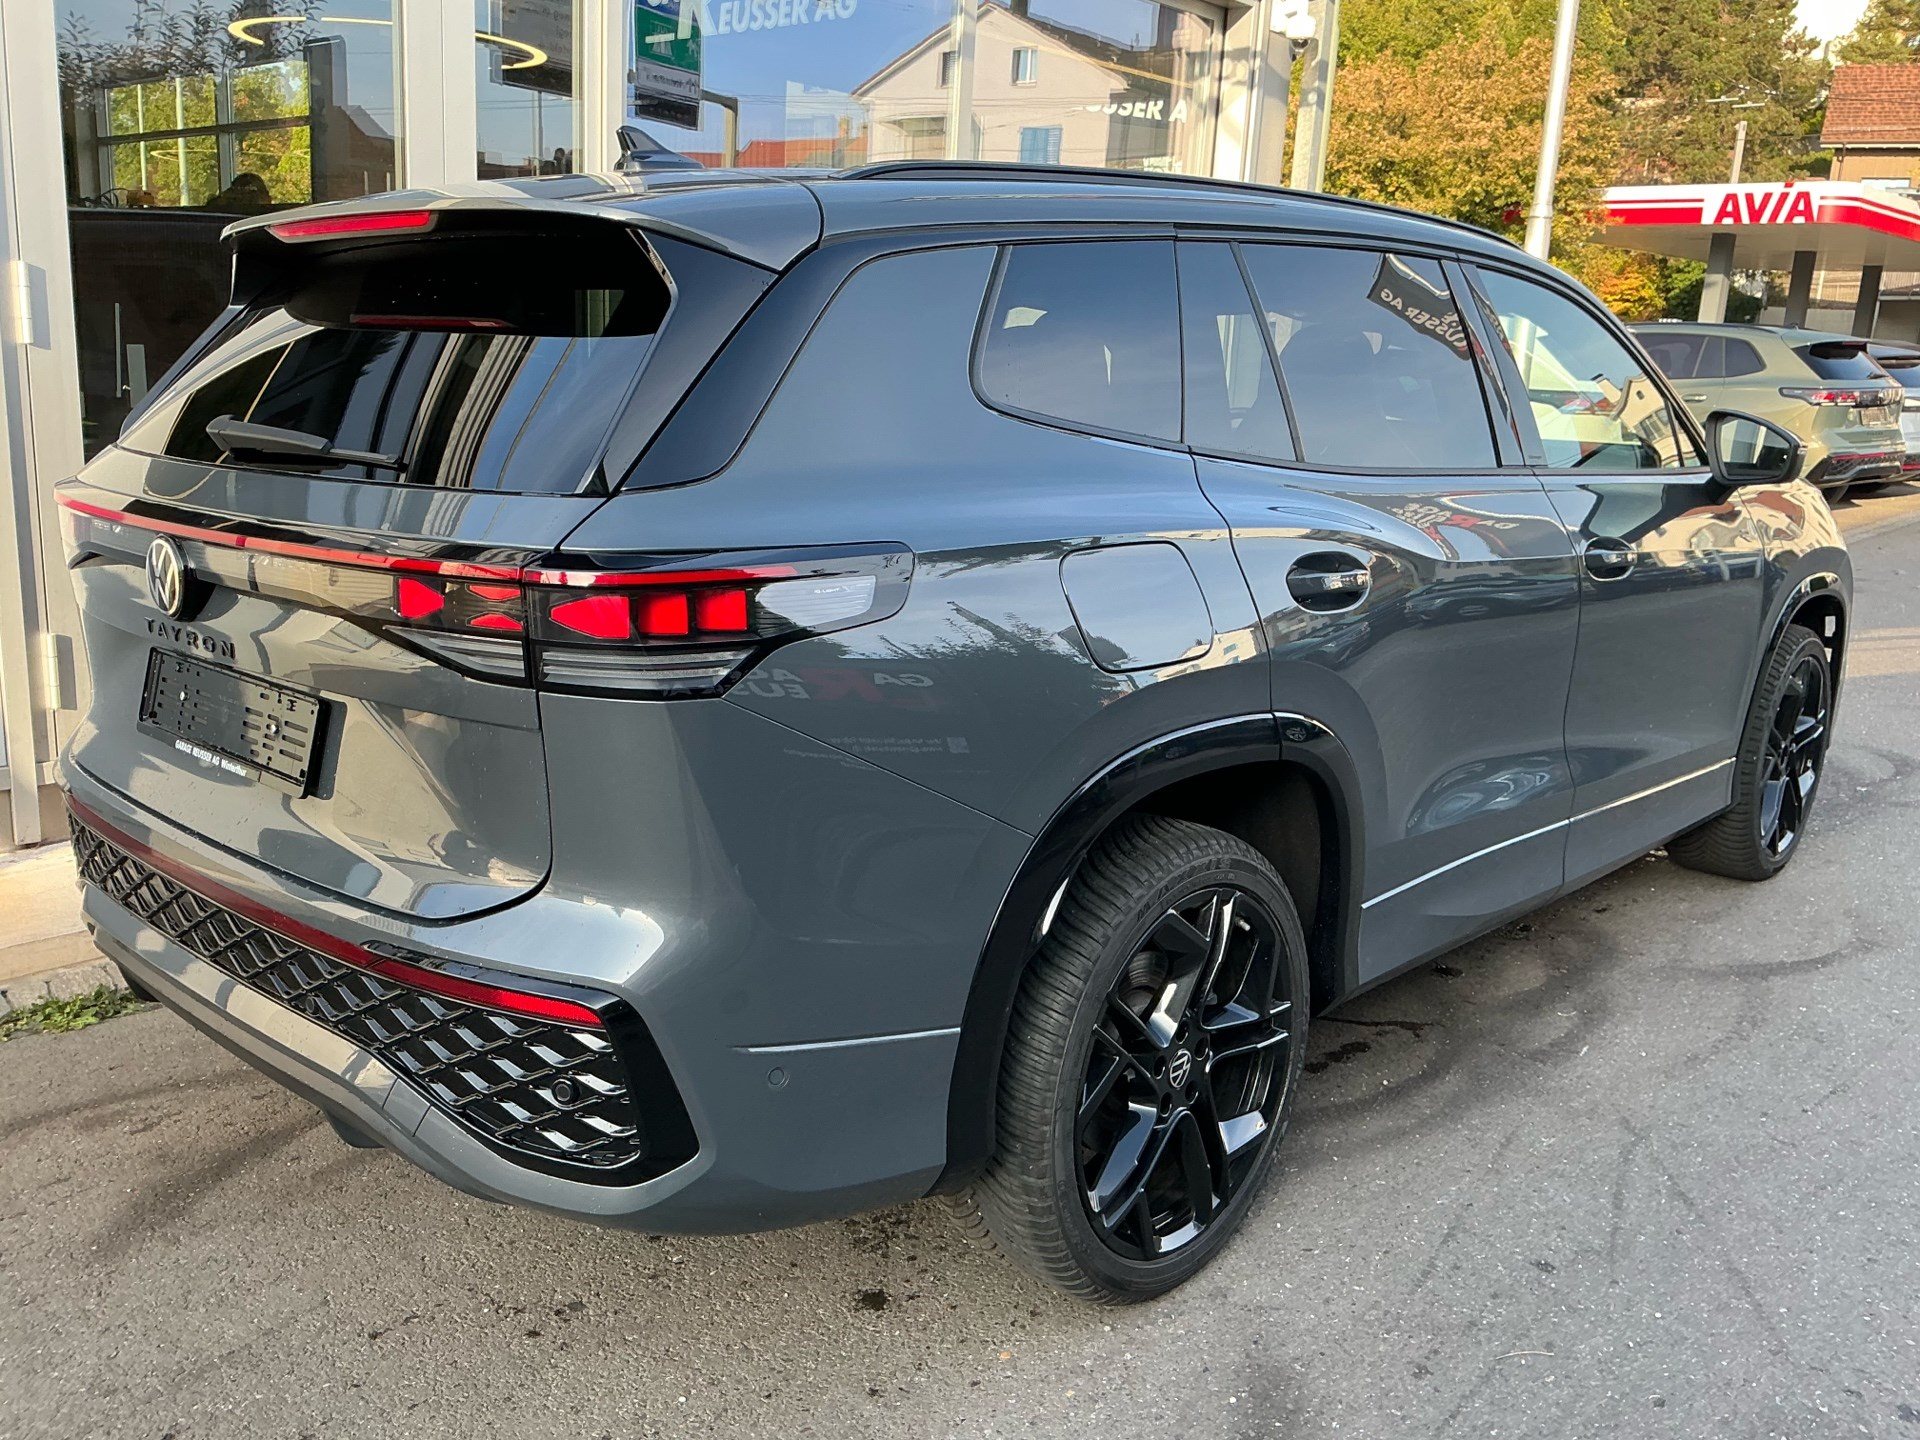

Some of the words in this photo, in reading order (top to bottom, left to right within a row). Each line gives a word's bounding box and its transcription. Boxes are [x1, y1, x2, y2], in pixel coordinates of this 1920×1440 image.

[814, 0, 858, 23] AG
[1713, 180, 1817, 225] AVIA
[145, 617, 236, 660] TAYRON
